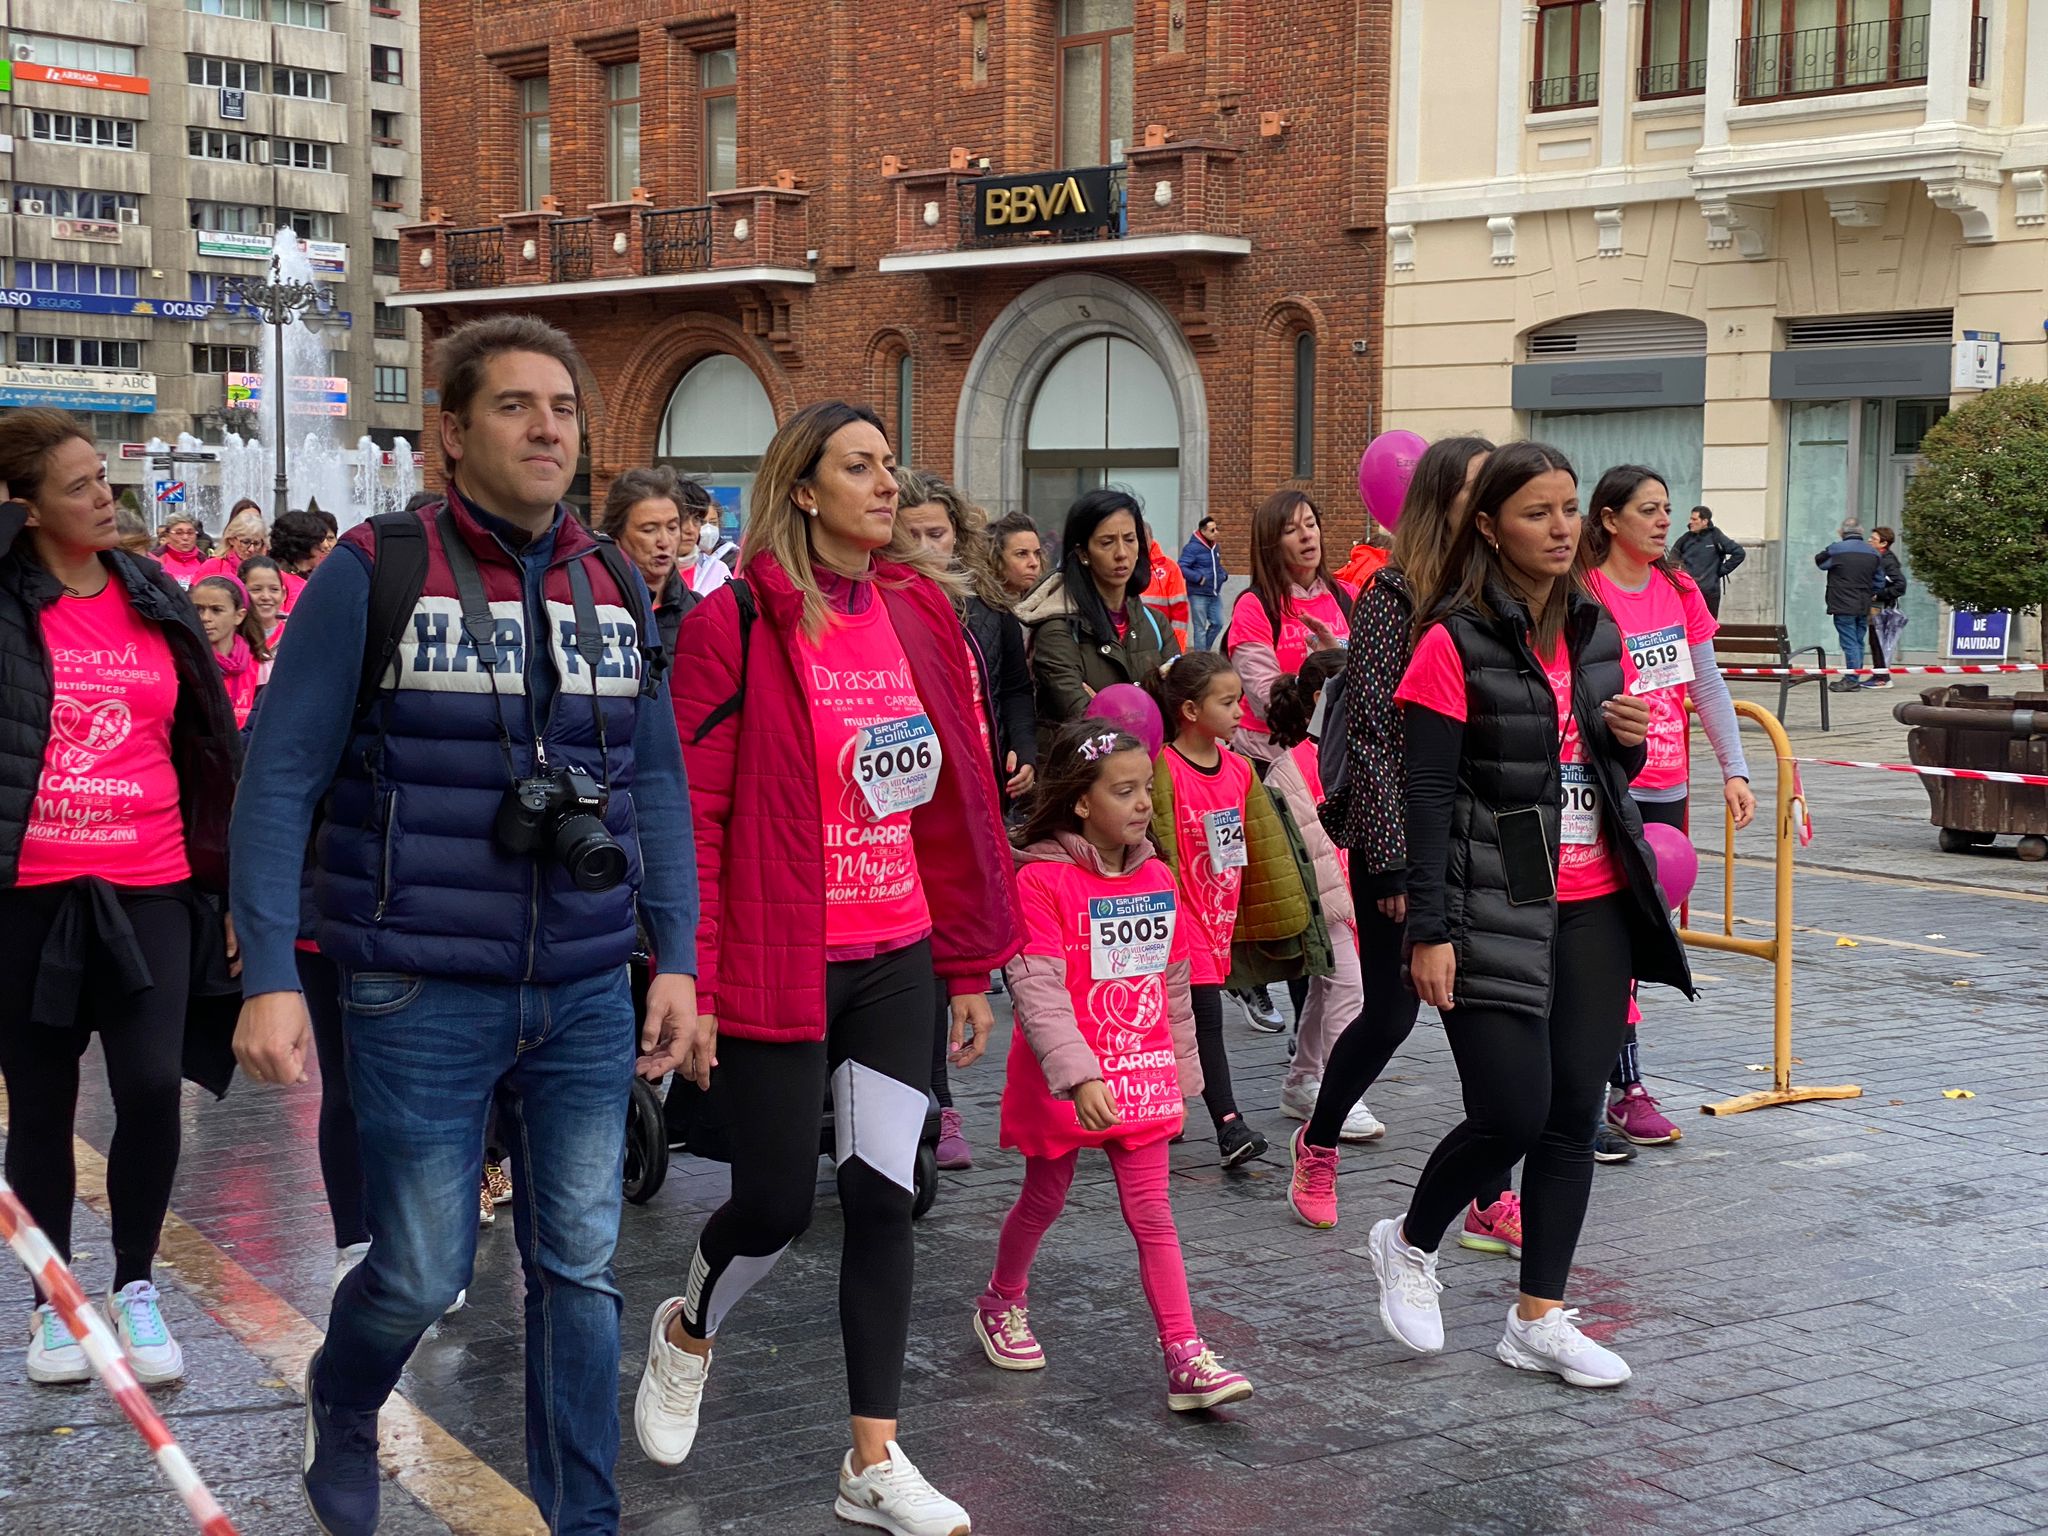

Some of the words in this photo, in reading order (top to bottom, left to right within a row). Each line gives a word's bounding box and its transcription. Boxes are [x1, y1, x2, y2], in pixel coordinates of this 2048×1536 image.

[985, 177, 1086, 226] BBVA
[224, 234, 267, 245] Abogados
[0, 291, 31, 306] ASO
[37, 297, 82, 309] SEGUROS
[20, 371, 53, 384] Nueva
[121, 376, 151, 388] ABC
[1973, 619, 1987, 631] DE
[1637, 631, 1662, 641] GRUPO
[1956, 637, 2001, 649] NAVIDAD
[54, 642, 138, 665] asanvi
[1632, 644, 1678, 670] 0619
[96, 668, 161, 681] CAROBELS
[811, 658, 912, 691] Drasanvi
[873, 720, 909, 735] GRUPO
[859, 741, 932, 782] 5006
[47, 775, 144, 798] CARRERA
[578, 796, 599, 804] Canon
[36, 796, 120, 829] Mujer
[70, 829, 137, 842] DRASANVI
[831, 851, 910, 886] Mujer
[1116, 896, 1150, 905] GRUPO
[1100, 916, 1169, 946] 5005
[1141, 943, 1166, 952] CARRERA
[1107, 1076, 1171, 1107] Mujer
